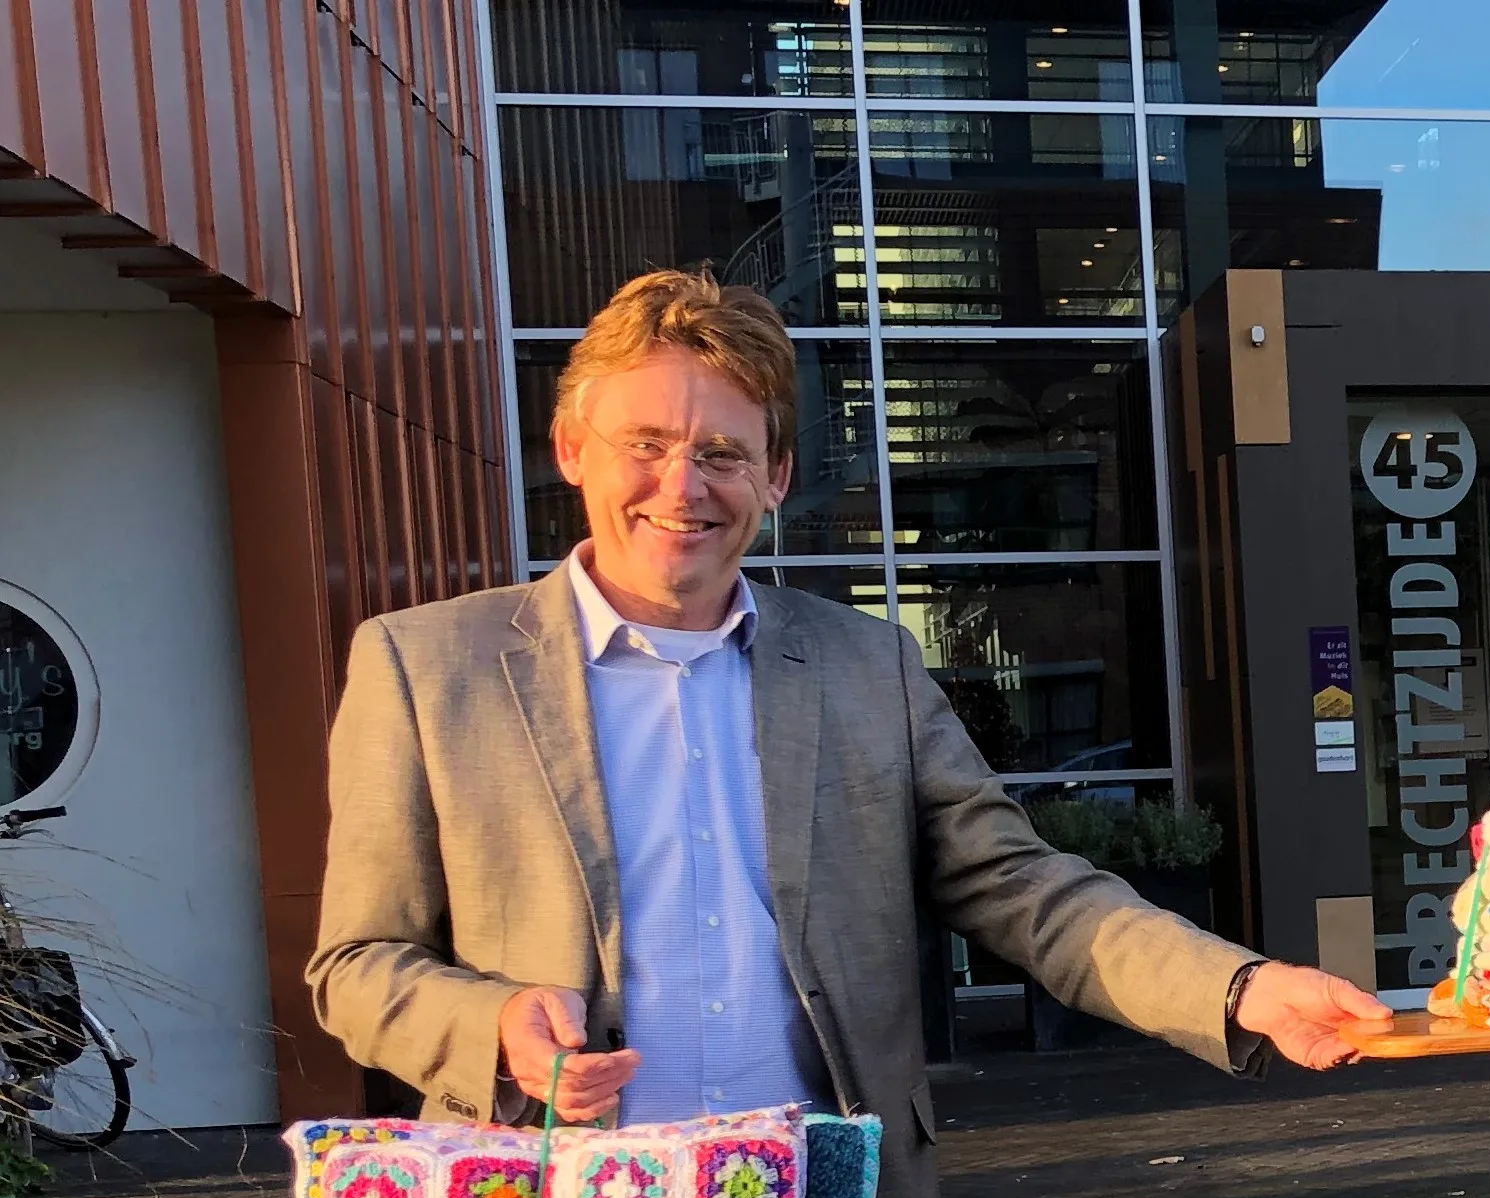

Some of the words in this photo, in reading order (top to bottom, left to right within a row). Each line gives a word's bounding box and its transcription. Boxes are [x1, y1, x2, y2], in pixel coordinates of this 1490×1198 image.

[1373, 432, 1464, 490] 45
[1319, 652, 1348, 660] Muziek
[1386, 520, 1471, 986] BRECHTZIJDE
